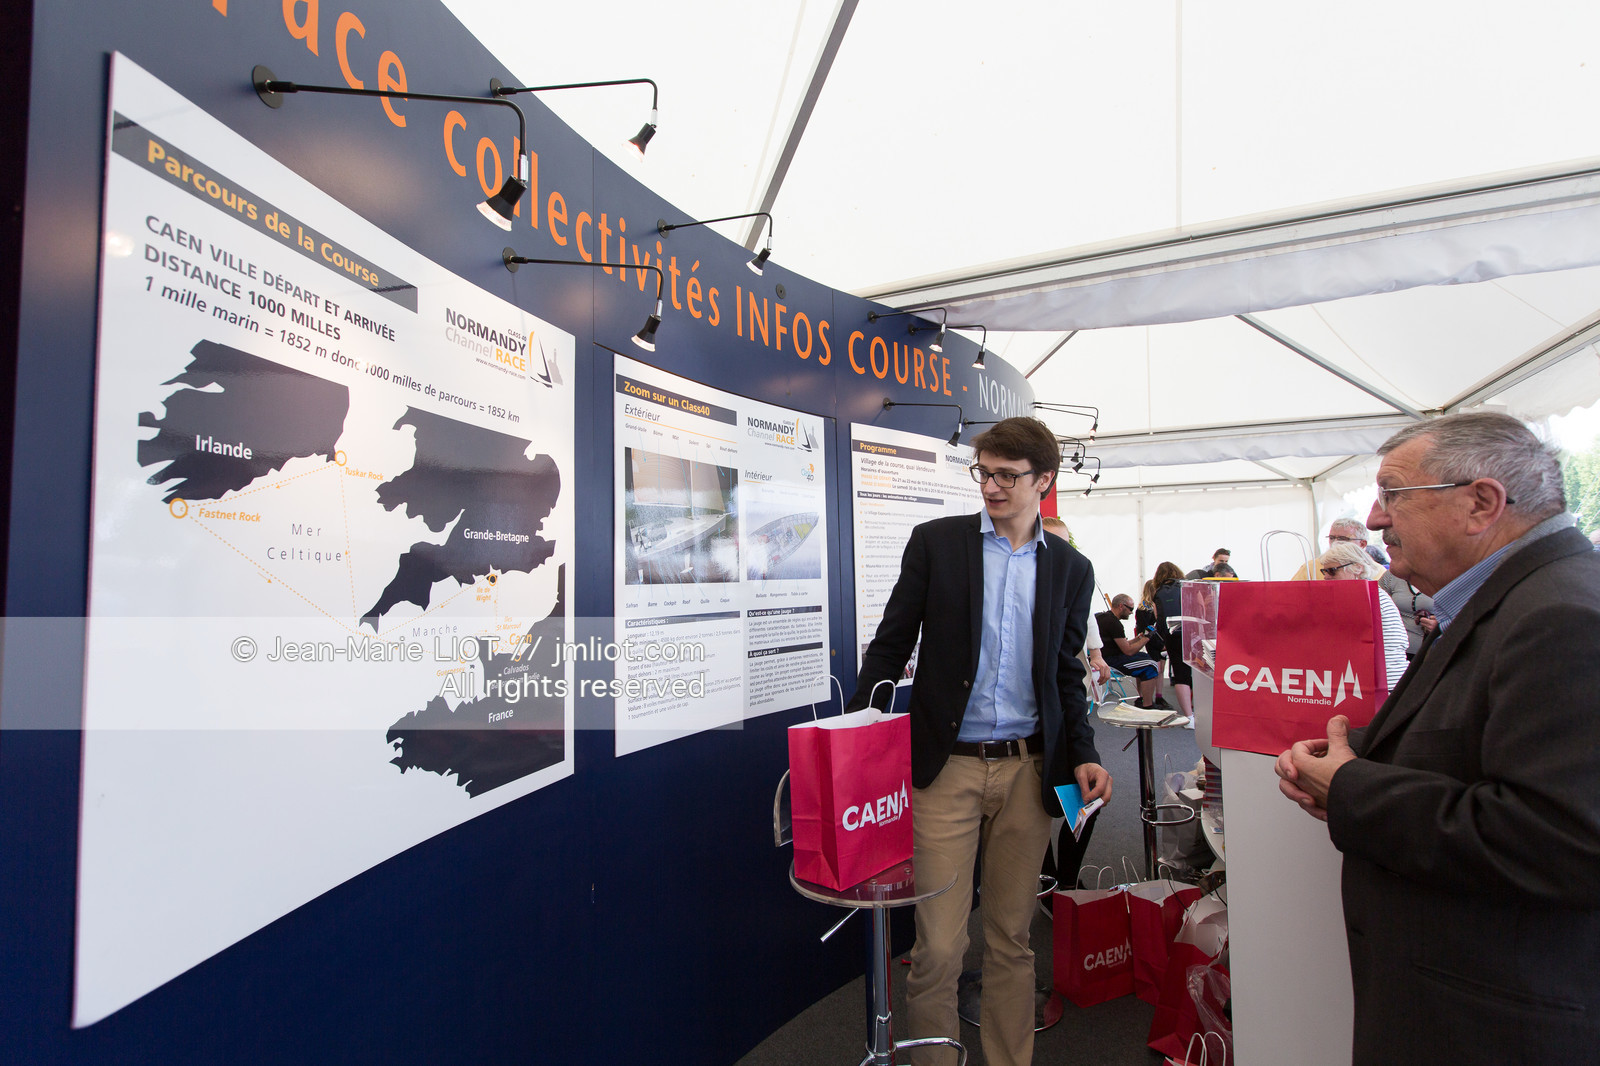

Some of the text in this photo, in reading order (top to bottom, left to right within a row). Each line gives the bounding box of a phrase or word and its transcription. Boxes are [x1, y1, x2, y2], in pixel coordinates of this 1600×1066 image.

[211, 0, 408, 128] ace
[443, 110, 721, 327] collectivités
[735, 285, 832, 365] INFOS
[847, 330, 953, 396] COURSE
[148, 139, 380, 287] Parcours de la Course
[145, 215, 396, 342] CAEN VILLE DÉPART ET ARRIVÉE
[144, 243, 341, 340] DISTANCE 1000 MILLES
[446, 307, 526, 356] NORMANDY
[145, 275, 154, 292] 1
[161, 281, 207, 313] mille
[212, 306, 259, 333] marin
[264, 327, 274, 338] =
[280, 329, 311, 353] 1852
[315, 346, 328, 358] m
[331, 349, 361, 371] donc
[364, 361, 390, 381] 1000
[392, 374, 422, 392] milles
[424, 383, 437, 397] de
[438, 390, 477, 410] parcours
[487, 405, 506, 419] 1852
[508, 410, 520, 423] km
[445, 326, 526, 372] Channel RACE
[624, 380, 710, 417] Zoom sur un Class40
[624, 403, 661, 422] Extérieur
[747, 416, 795, 435] NORMANDY
[747, 427, 795, 445] Channel RACE
[195, 434, 253, 460] Irlande
[859, 442, 897, 455] Programme
[860, 457, 877, 466] Village
[345, 467, 384, 481] Tuskar Rock
[744, 469, 773, 482] Intérieur
[198, 507, 262, 523] Fastnet Rock
[291, 523, 322, 537] Mer
[463, 528, 530, 545] Grande-Bretagne
[266, 547, 342, 563] Celtique
[412, 624, 458, 638] Manche
[627, 618, 666, 627] Caractéristiques
[503, 663, 530, 675] Calvados
[1223, 664, 1333, 697] CAEN
[1287, 695, 1332, 706] Normandie
[488, 708, 514, 723] France
[842, 791, 899, 831] CAEN
[1083, 945, 1124, 971] CAEN
